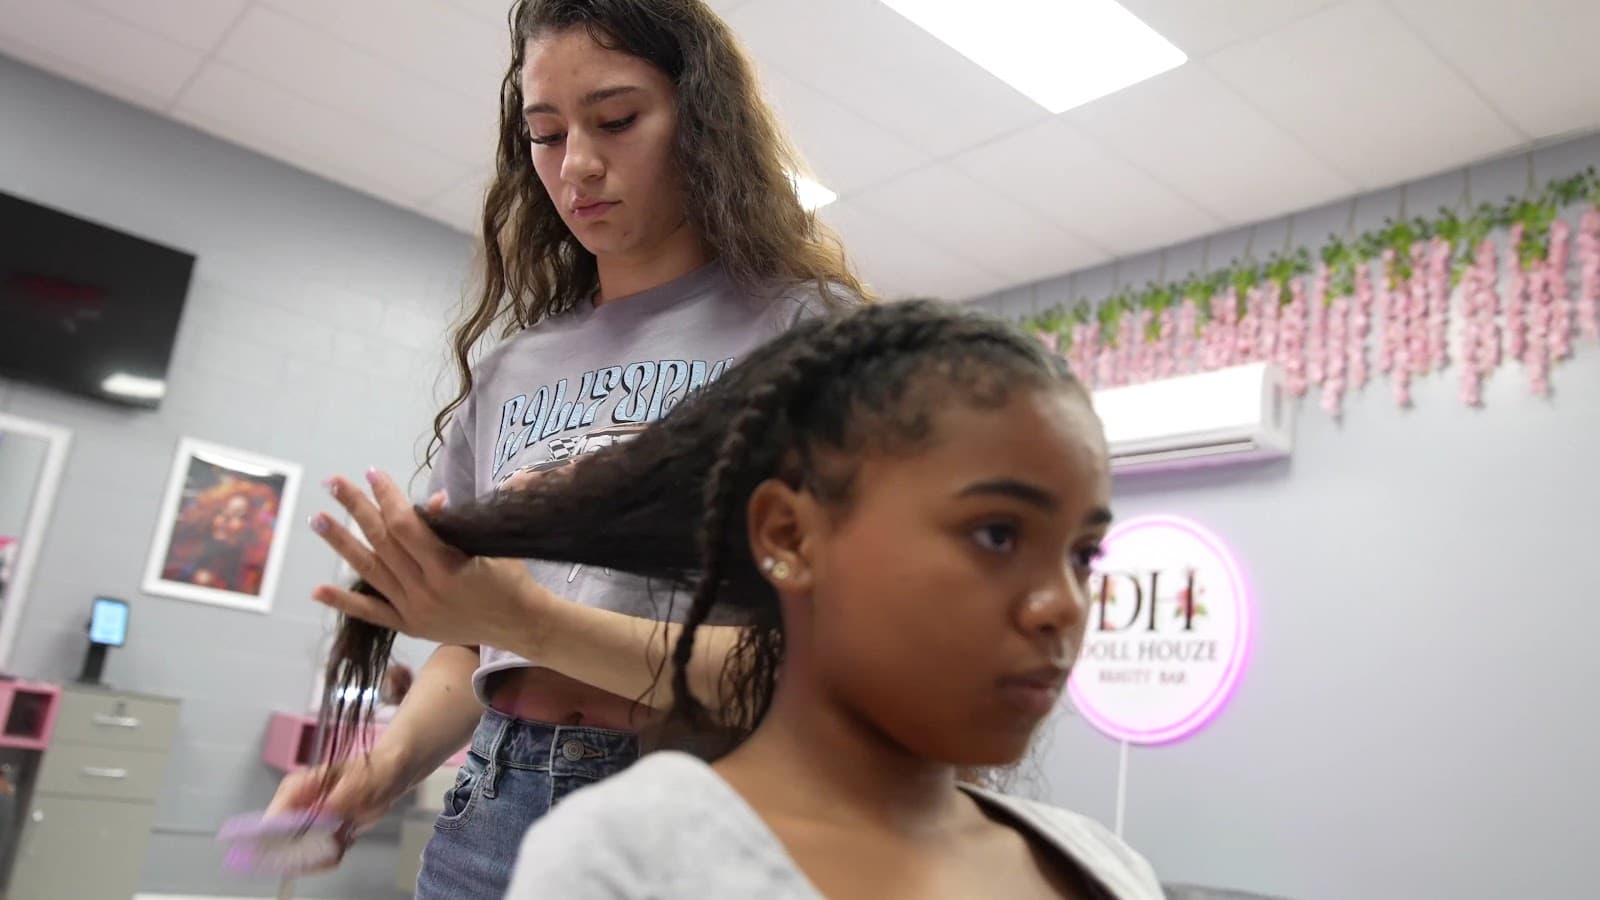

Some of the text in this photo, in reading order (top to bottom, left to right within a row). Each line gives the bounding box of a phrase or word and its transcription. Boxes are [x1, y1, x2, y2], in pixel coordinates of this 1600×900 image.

[492, 357, 735, 481] CALIFOR
[1096, 567, 1201, 632] DH
[1137, 639, 1218, 662] HOUZE
[1159, 671, 1186, 686] BAR
